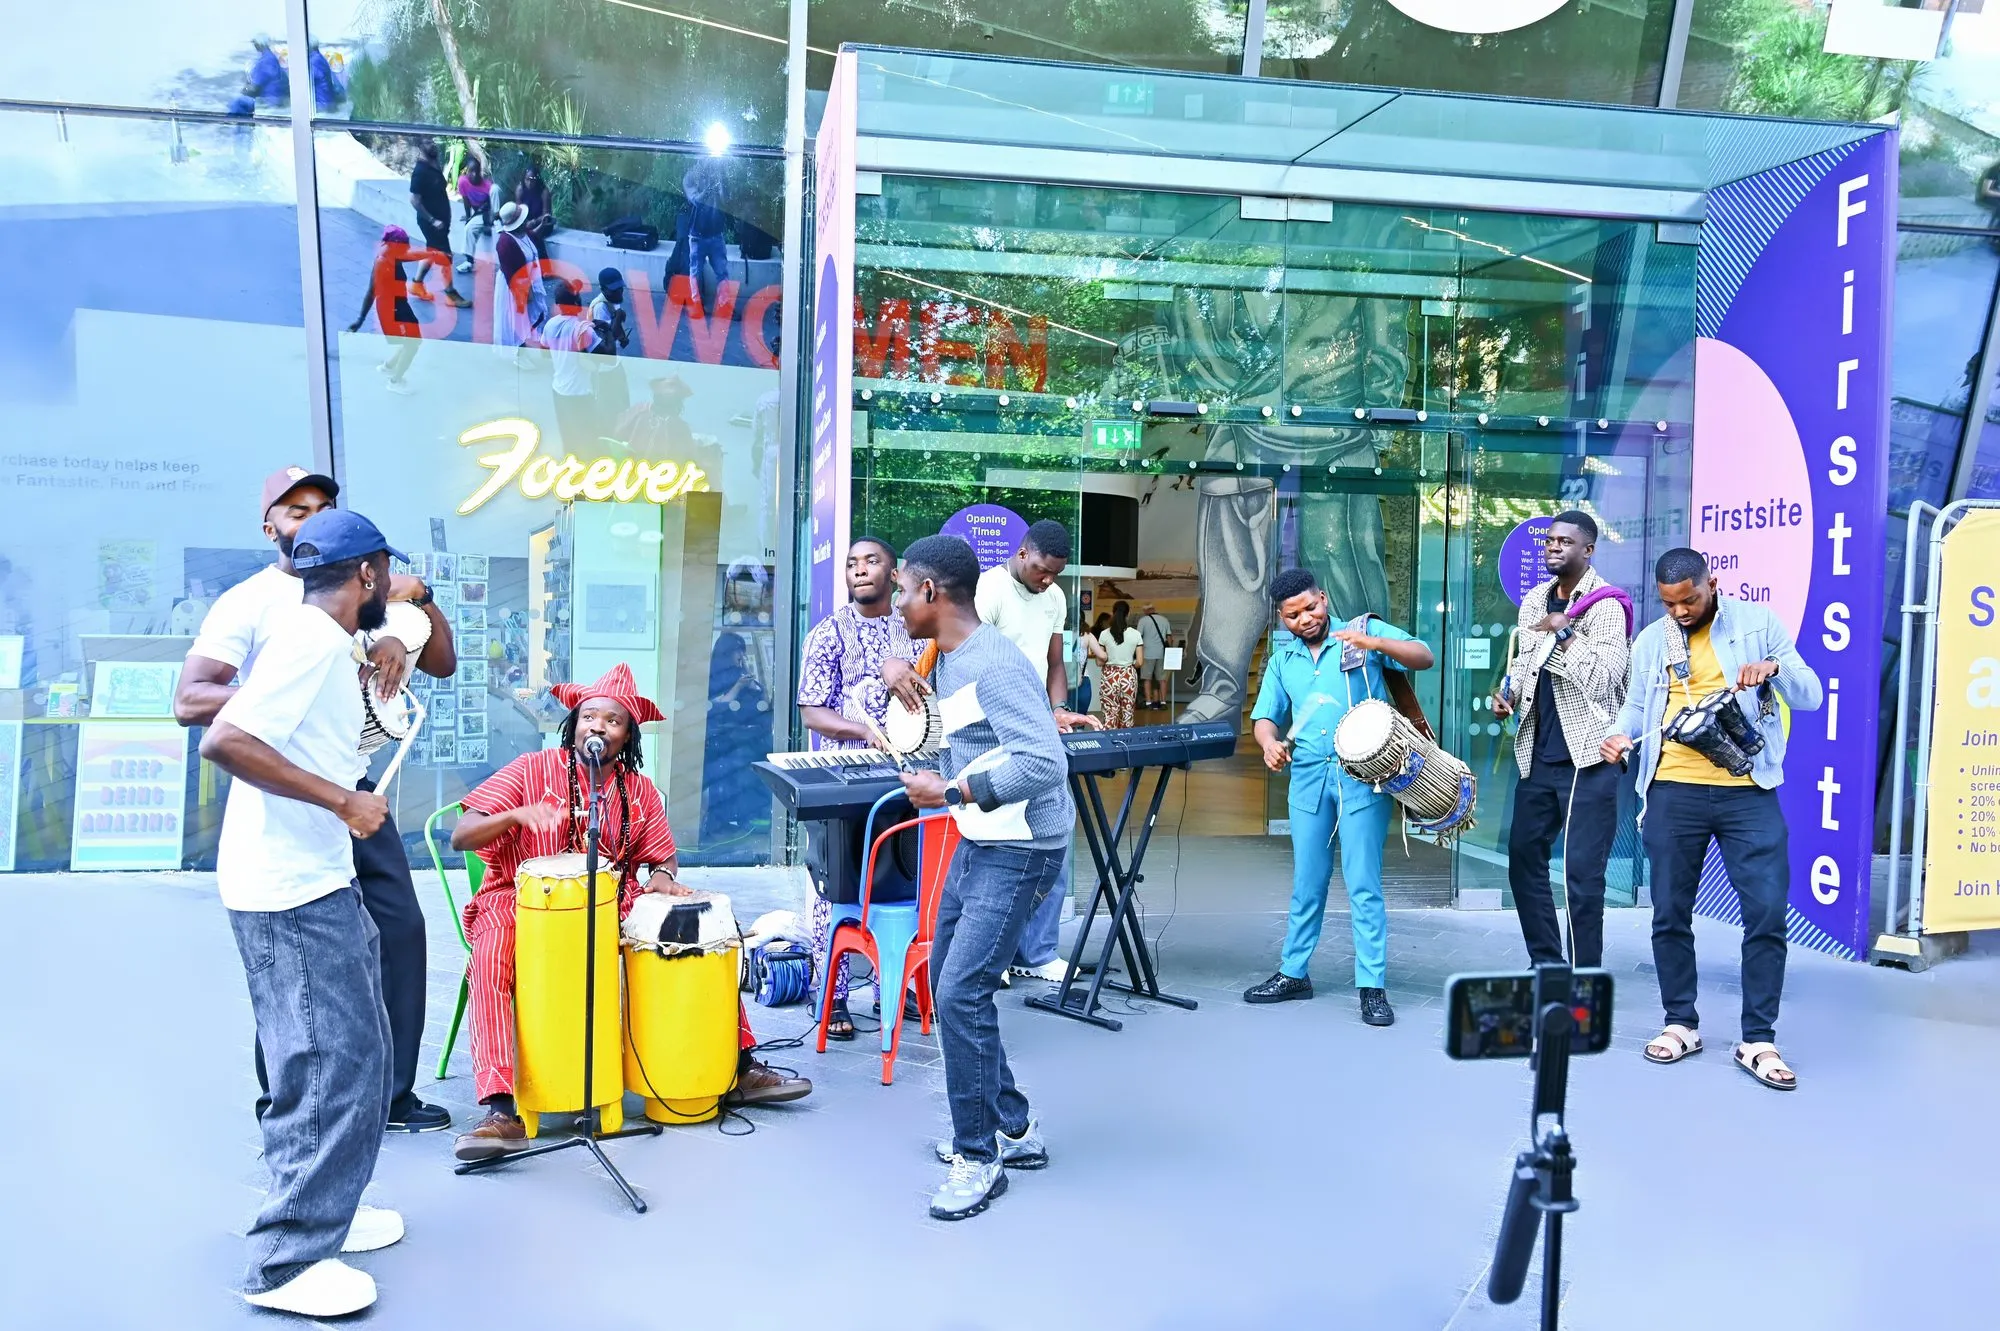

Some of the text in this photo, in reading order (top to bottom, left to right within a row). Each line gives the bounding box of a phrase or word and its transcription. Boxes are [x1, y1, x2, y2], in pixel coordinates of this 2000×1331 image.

[64, 456, 110, 471] today
[114, 458, 158, 473] helps
[163, 460, 200, 475] keep
[457, 417, 710, 516] Forever
[110, 477, 141, 490] Fun
[146, 480, 176, 491] and
[966, 514, 1007, 526] Opening
[1701, 497, 1803, 533] Firstsite
[971, 526, 1001, 536] Times
[1810, 172, 1869, 906] Firstsite
[1740, 582, 1771, 603] Sun
[1074, 740, 1102, 750] YAMAHA
[1961, 729, 1998, 747] Join
[110, 758, 163, 779] KEEP
[100, 785, 165, 806] BEING
[1970, 795, 1996, 807] 20%
[81, 812, 178, 833] AMAZING
[1970, 811, 1996, 822] 20%
[1971, 826, 1996, 838] 10%
[1970, 842, 1987, 853] No
[1954, 879, 1990, 897] Join
